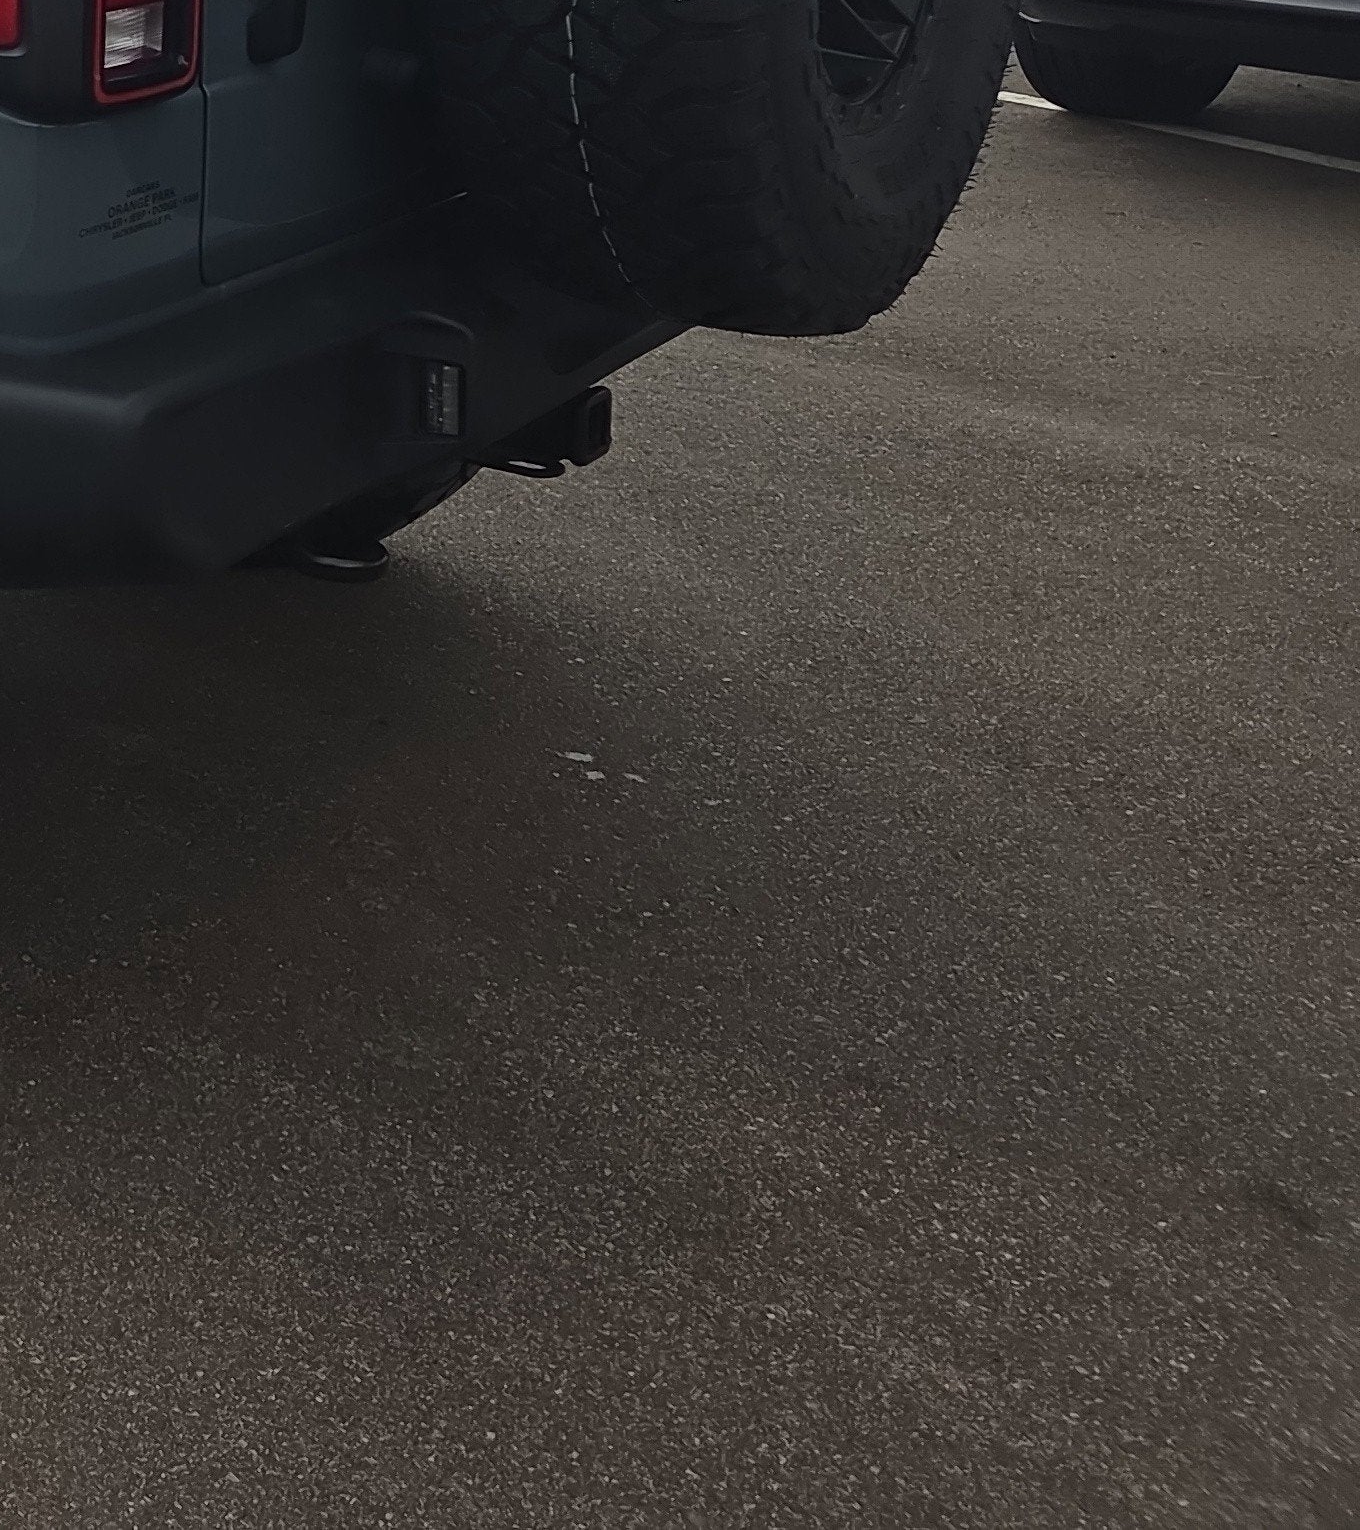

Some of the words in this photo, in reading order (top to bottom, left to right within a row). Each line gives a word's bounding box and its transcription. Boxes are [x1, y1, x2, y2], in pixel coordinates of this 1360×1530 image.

[78, 217, 123, 238] CHRYSLER
[152, 198, 178, 215] DODGE
[108, 194, 152, 218] ORANGE
[152, 187, 176, 204] PARK
